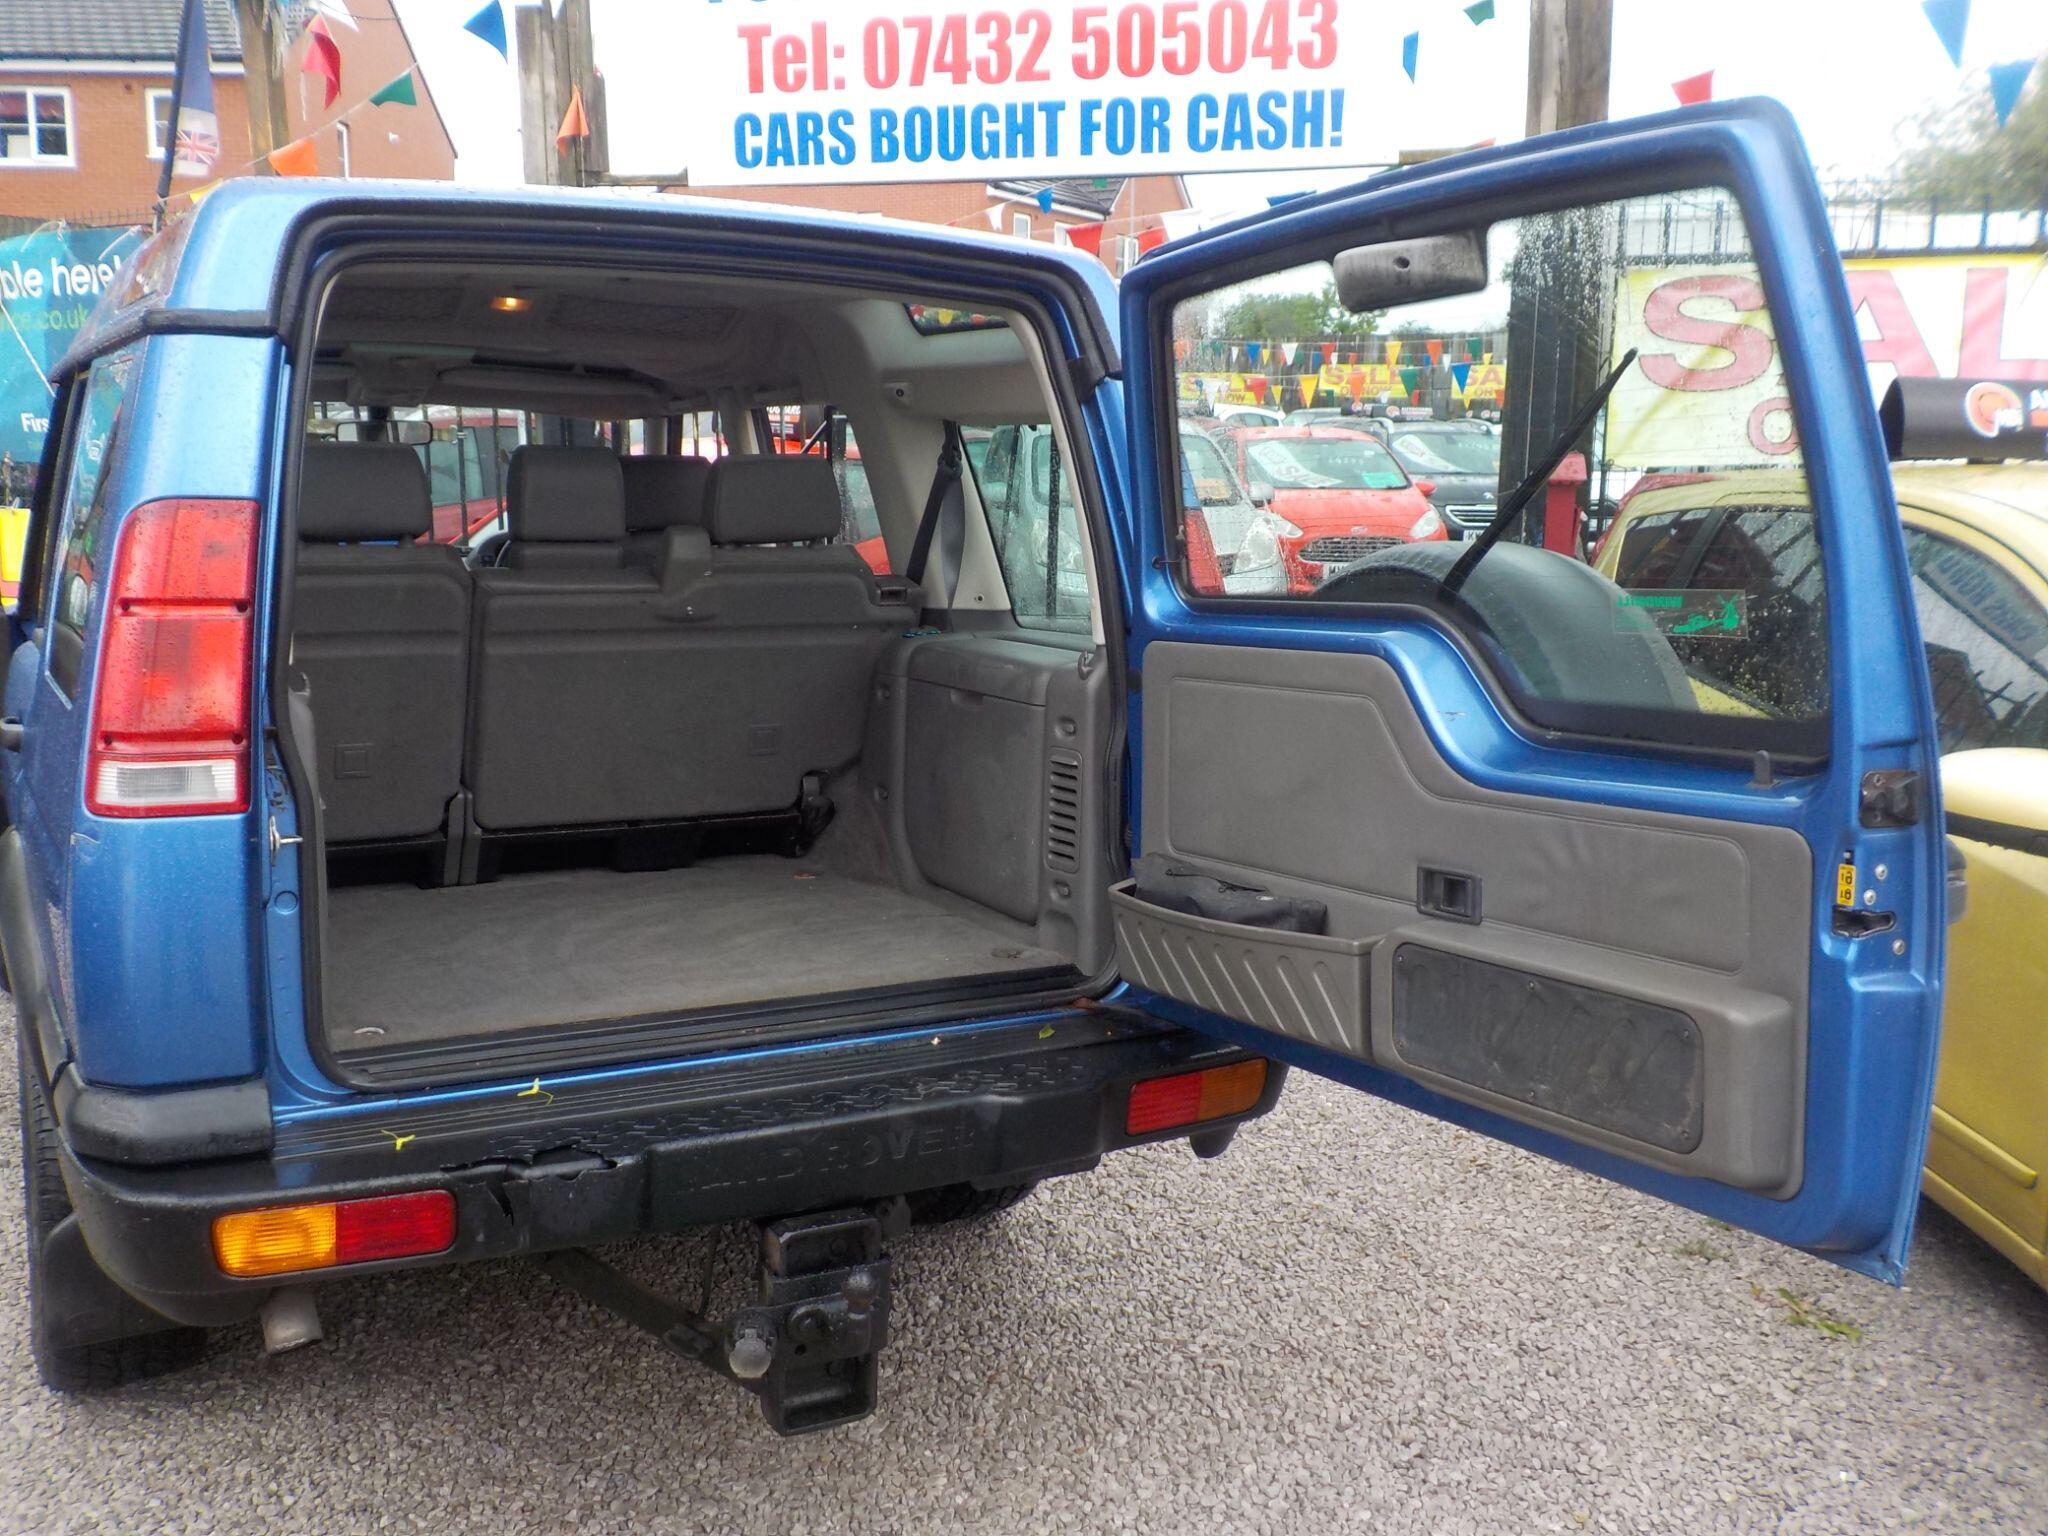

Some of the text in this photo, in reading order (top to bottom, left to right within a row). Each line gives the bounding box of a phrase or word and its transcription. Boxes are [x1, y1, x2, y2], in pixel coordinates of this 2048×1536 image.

[737, 0, 1338, 94] Tel: 07432 505043
[734, 88, 1345, 169] CARS BOUGHT FOR CASH!
